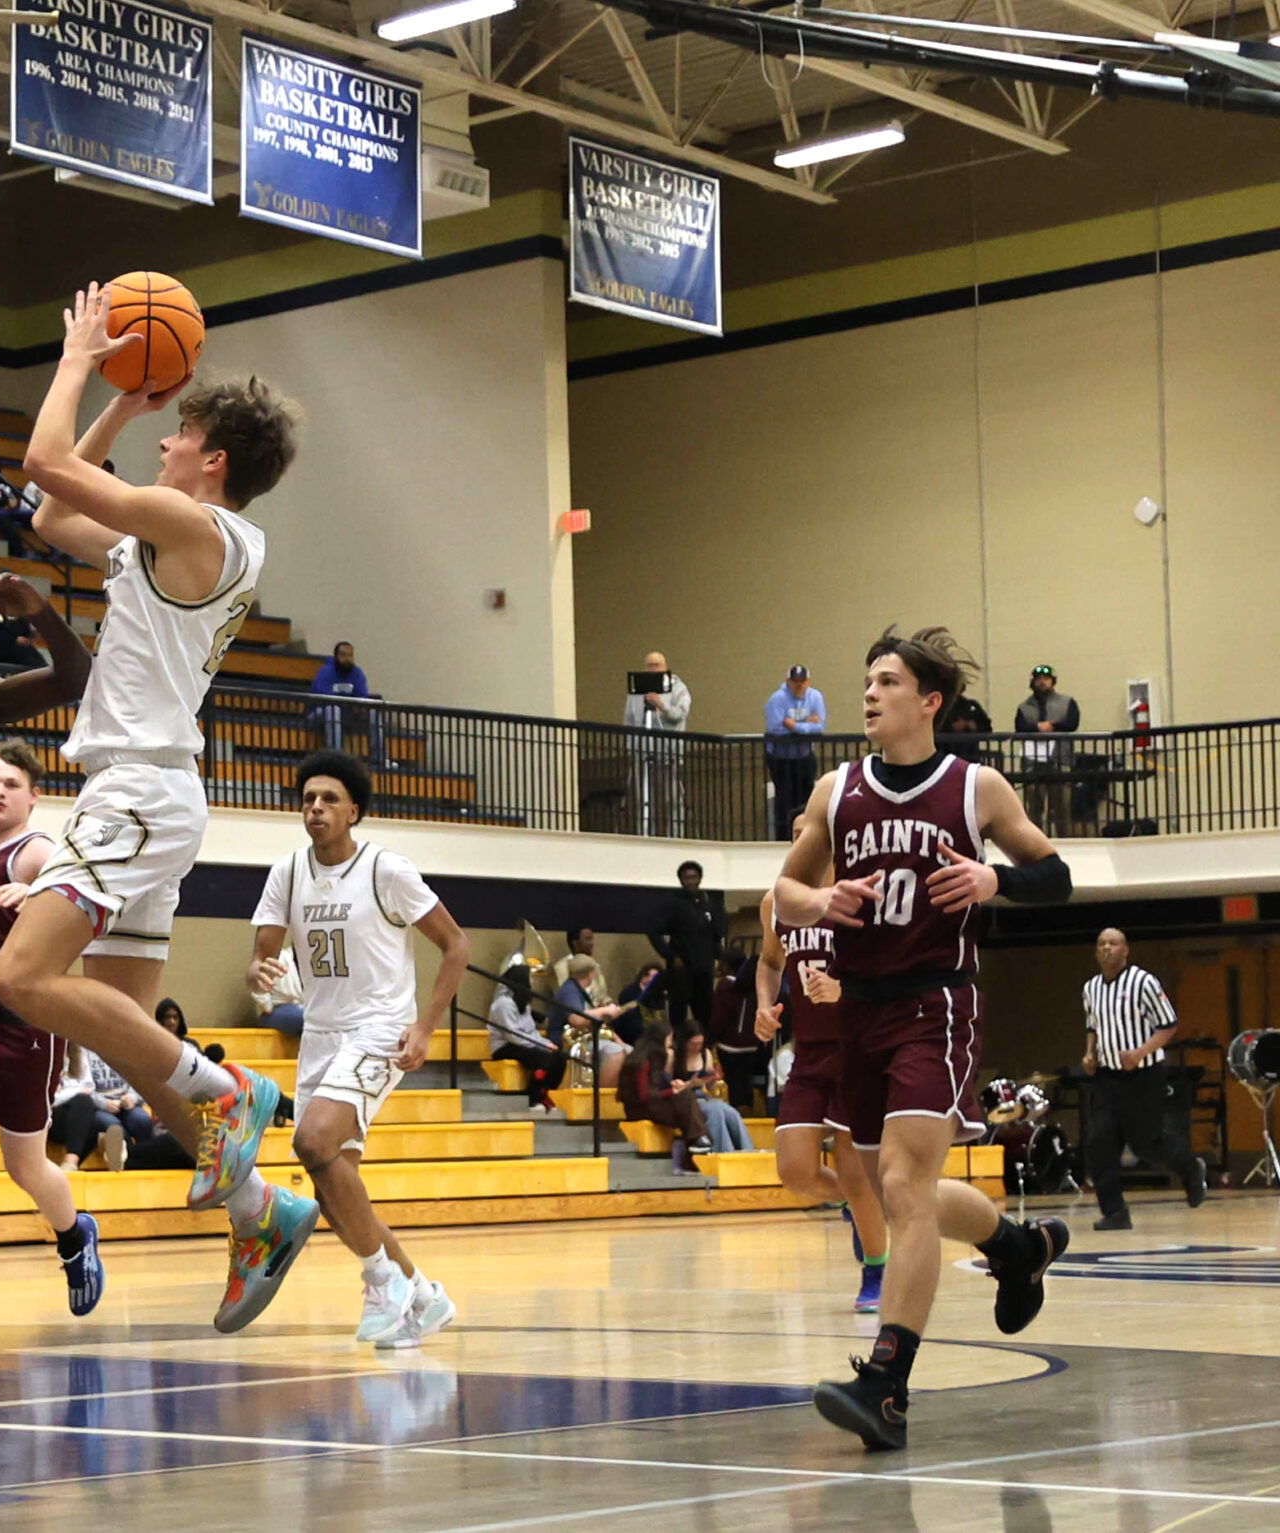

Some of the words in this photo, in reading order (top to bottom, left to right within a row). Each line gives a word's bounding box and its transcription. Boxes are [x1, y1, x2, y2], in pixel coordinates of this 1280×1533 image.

[134, 11, 203, 52] GIRLS
[56, 50, 91, 73] AREA
[95, 61, 175, 96] CHAMPIONS
[60, 69, 92, 95] 2014,
[252, 48, 343, 96] VARSITY
[349, 77, 412, 116] GIRLS
[259, 79, 405, 143] BASKETBALL
[45, 128, 110, 163] GOLDEN
[117, 148, 176, 180] EAGLES
[265, 112, 320, 141] COUNTY
[322, 128, 399, 163] CHAMPIONS
[578, 146, 654, 187] VARSITY
[659, 170, 713, 204] GIRLS
[272, 190, 330, 222] GOLDEN
[581, 175, 711, 233] BASKETBALL
[303, 903, 352, 923] VILLE
[873, 868, 918, 927] 10
[307, 928, 349, 977] 21
